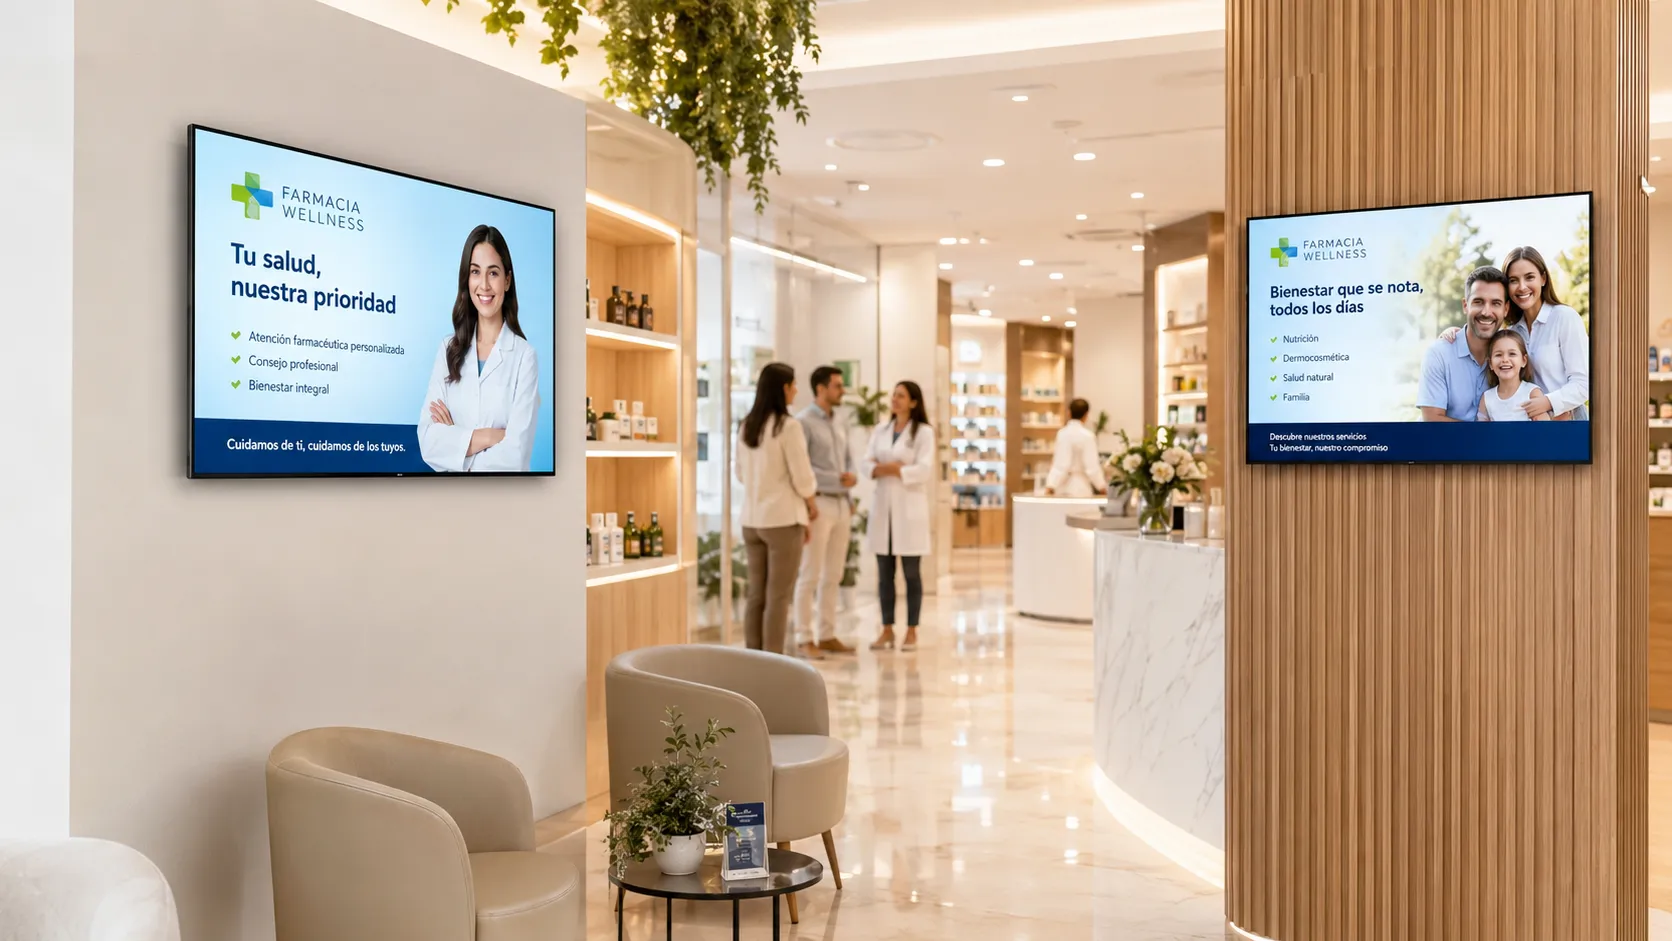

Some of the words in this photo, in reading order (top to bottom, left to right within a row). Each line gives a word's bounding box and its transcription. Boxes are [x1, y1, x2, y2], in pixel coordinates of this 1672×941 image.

[282, 186, 360, 214] FARMACIA
[282, 205, 364, 231] WELLNESS
[1303, 237, 1364, 249] FARMACIA
[231, 242, 256, 266] Tu
[263, 250, 321, 278] salud,
[1304, 249, 1367, 261] WELLNESS
[232, 280, 307, 303] nuestra
[314, 288, 396, 314] prioridad
[1271, 285, 1334, 298] Bienestar
[1338, 285, 1364, 298] que
[1368, 284, 1383, 294] se
[1388, 281, 1423, 294] nota,
[1270, 303, 1308, 316] todos
[1313, 301, 1331, 314] los
[1336, 300, 1364, 313] días
[249, 331, 291, 345] Atención
[293, 335, 348, 350] farmacéutica
[350, 342, 405, 355] personalizada
[1283, 335, 1319, 343] Nutrición
[249, 355, 287, 370] Consejo
[290, 358, 338, 371] profesional
[1283, 353, 1349, 362] Dermocosmética
[1283, 373, 1304, 382] Salud
[1306, 373, 1334, 381] natural
[249, 380, 293, 392] Bienestar
[296, 382, 329, 396] integral
[1283, 393, 1310, 401] Familia
[227, 438, 278, 450] Cuidamos
[281, 440, 293, 450] de
[296, 440, 305, 452] ti,
[308, 440, 351, 451] cuidamos
[353, 441, 364, 451] de
[367, 441, 379, 452] los
[381, 442, 405, 454] tuyos.
[1280, 444, 1313, 452] bienestar,
[1343, 444, 1388, 452] compromiso
